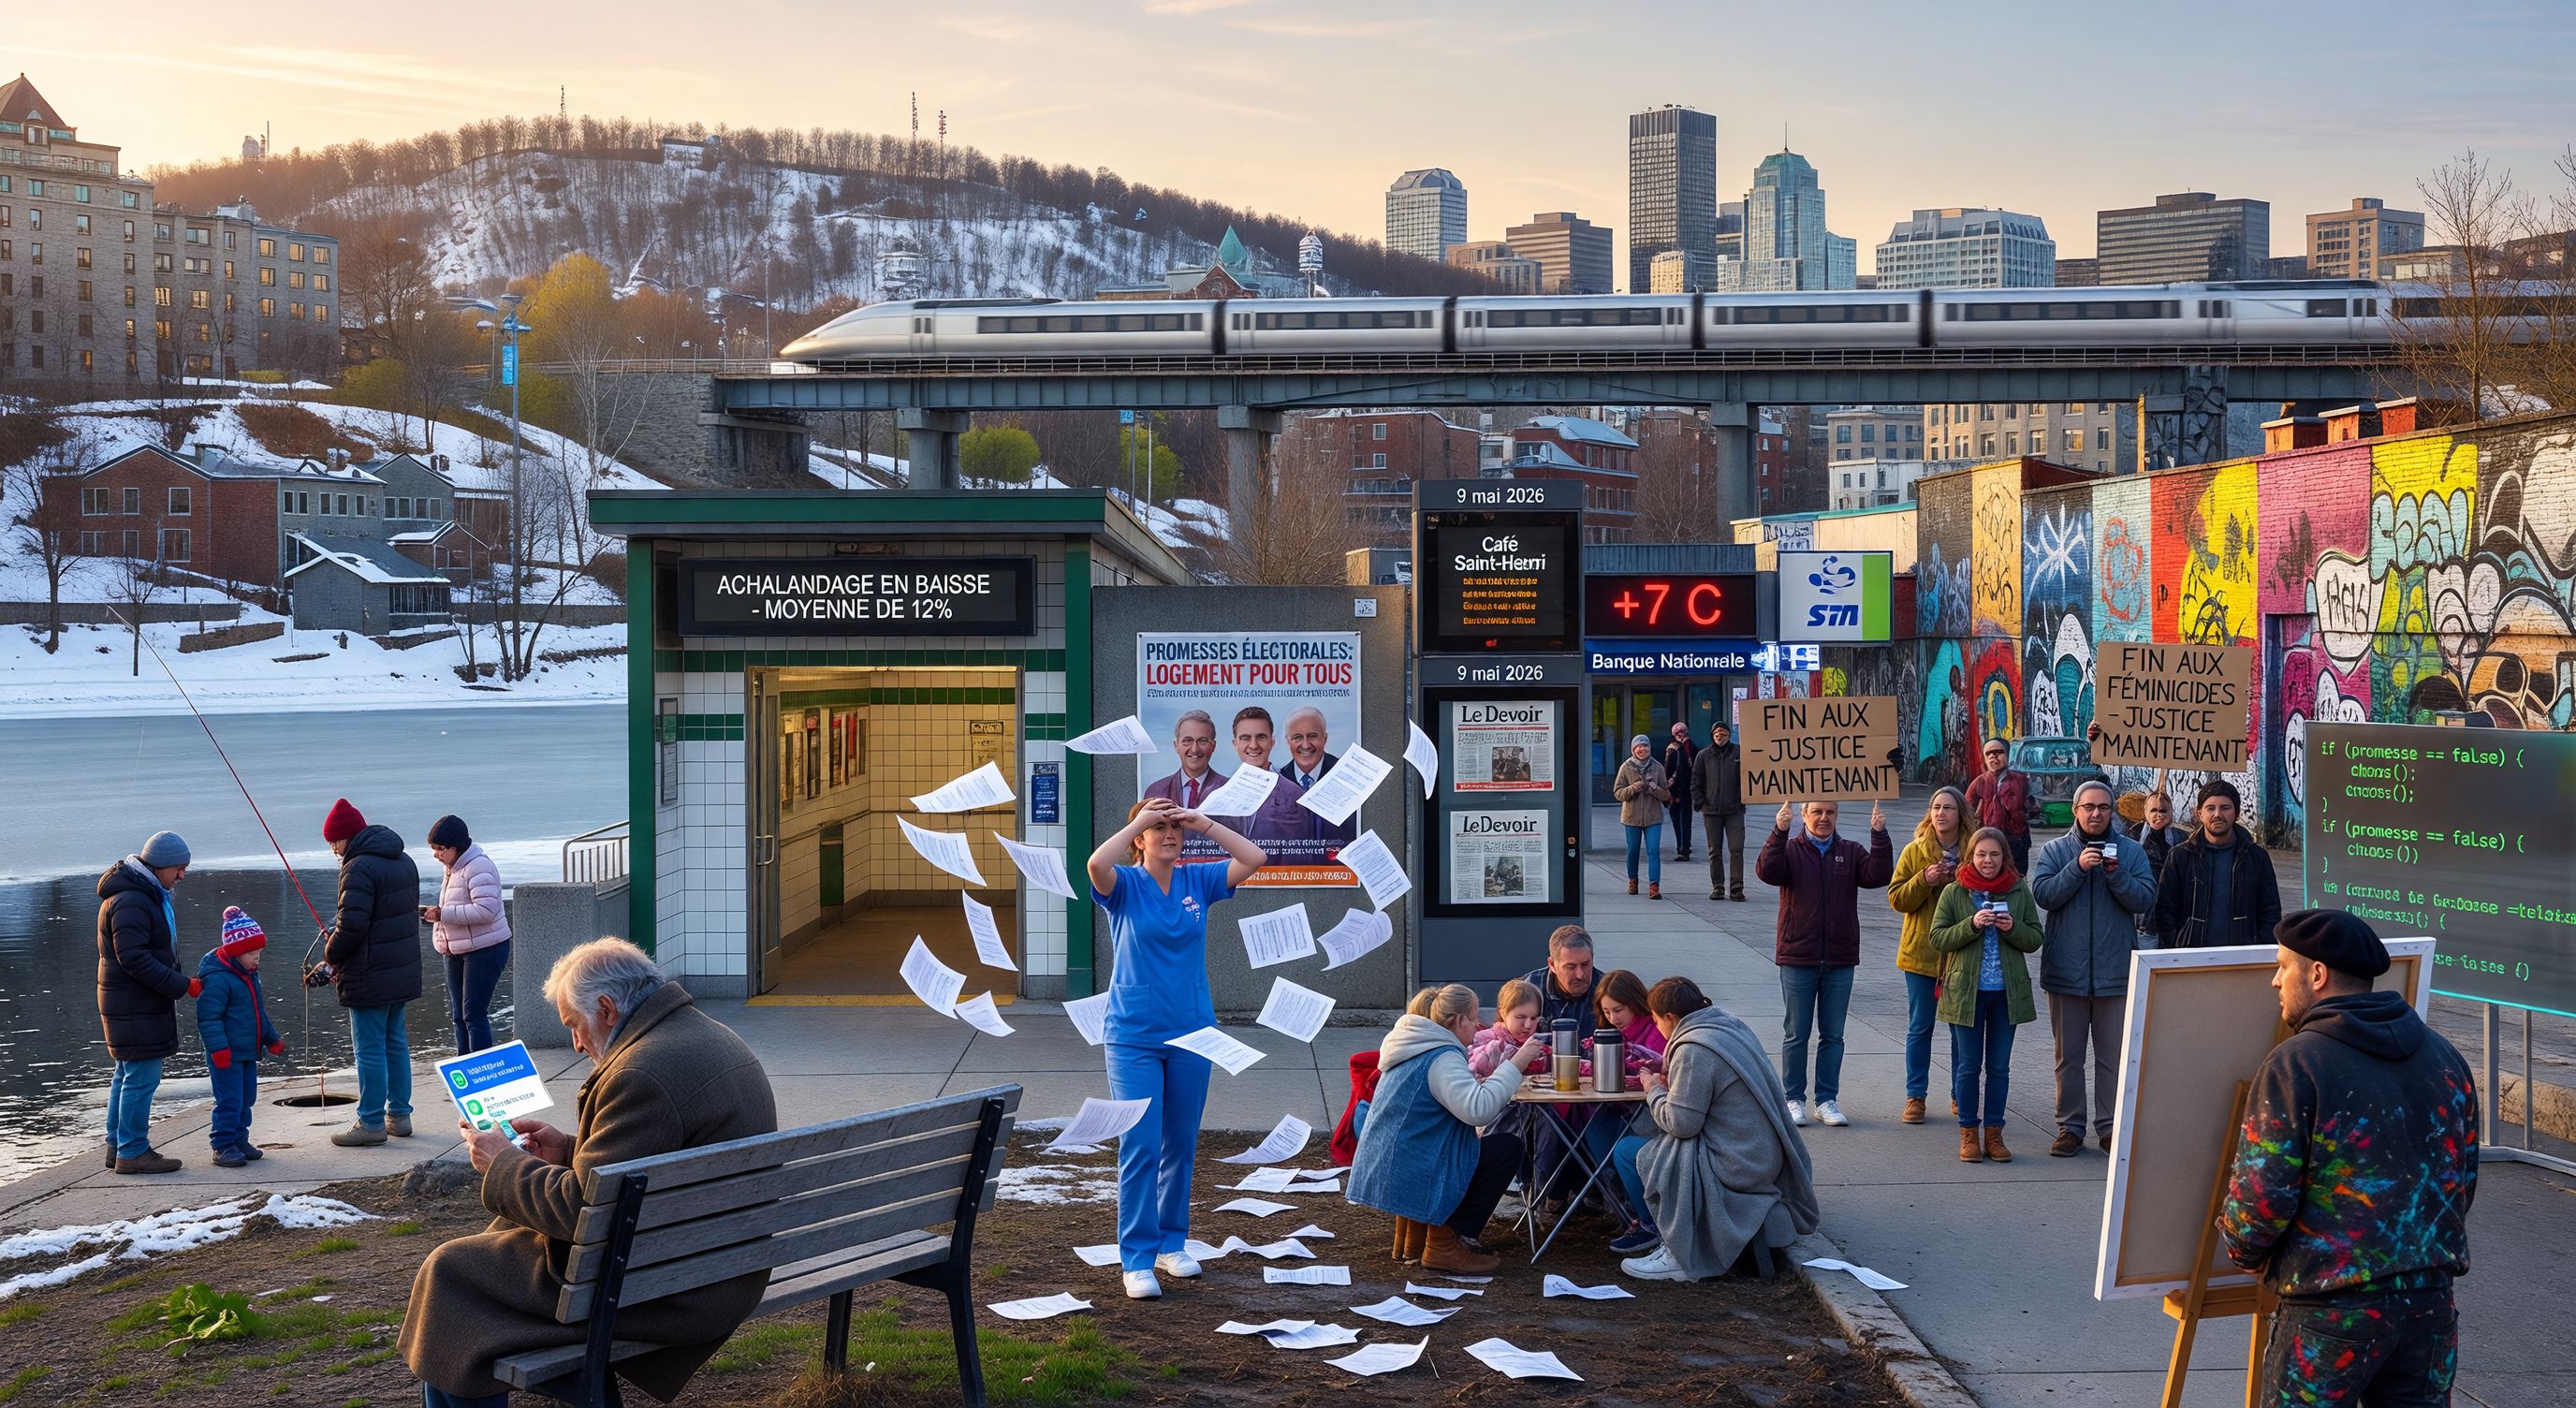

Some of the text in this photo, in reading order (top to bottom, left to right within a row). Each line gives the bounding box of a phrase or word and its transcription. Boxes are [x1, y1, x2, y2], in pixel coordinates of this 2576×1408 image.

[1456, 488, 1544, 504] 9 mai 2026
[1482, 535, 1518, 552] Café
[717, 574, 990, 595] ACHALANDAGE EN BAISSE
[765, 598, 870, 620] MOYENNE
[876, 598, 904, 619] DE
[912, 598, 953, 619] 12%
[1614, 583, 1722, 625] +7 C
[1146, 637, 1354, 661] PROMESSES ÉLECTORALES:
[1146, 662, 1354, 685] LOGEMENT POUR TOUS
[1456, 664, 1544, 681] 9 mai 2026
[1592, 653, 1655, 672] Banque
[2122, 647, 2225, 677] FIN AUX
[2108, 670, 2236, 706] FÉMINICIDES
[1461, 705, 1544, 723] Le Devoir
[1764, 702, 1869, 730] FIN AUX
[2102, 732, 2247, 764] MAINTENANT
[2321, 741, 2335, 755] if
[2345, 741, 2418, 760] (promesse
[2452, 747, 2506, 768] false)
[1748, 765, 1895, 797] MAINTENANT
[1463, 815, 1537, 833] Le Devoir
[2322, 818, 2336, 833] if
[2345, 819, 2419, 842] (promesse
[2452, 829, 2506, 852] false)
